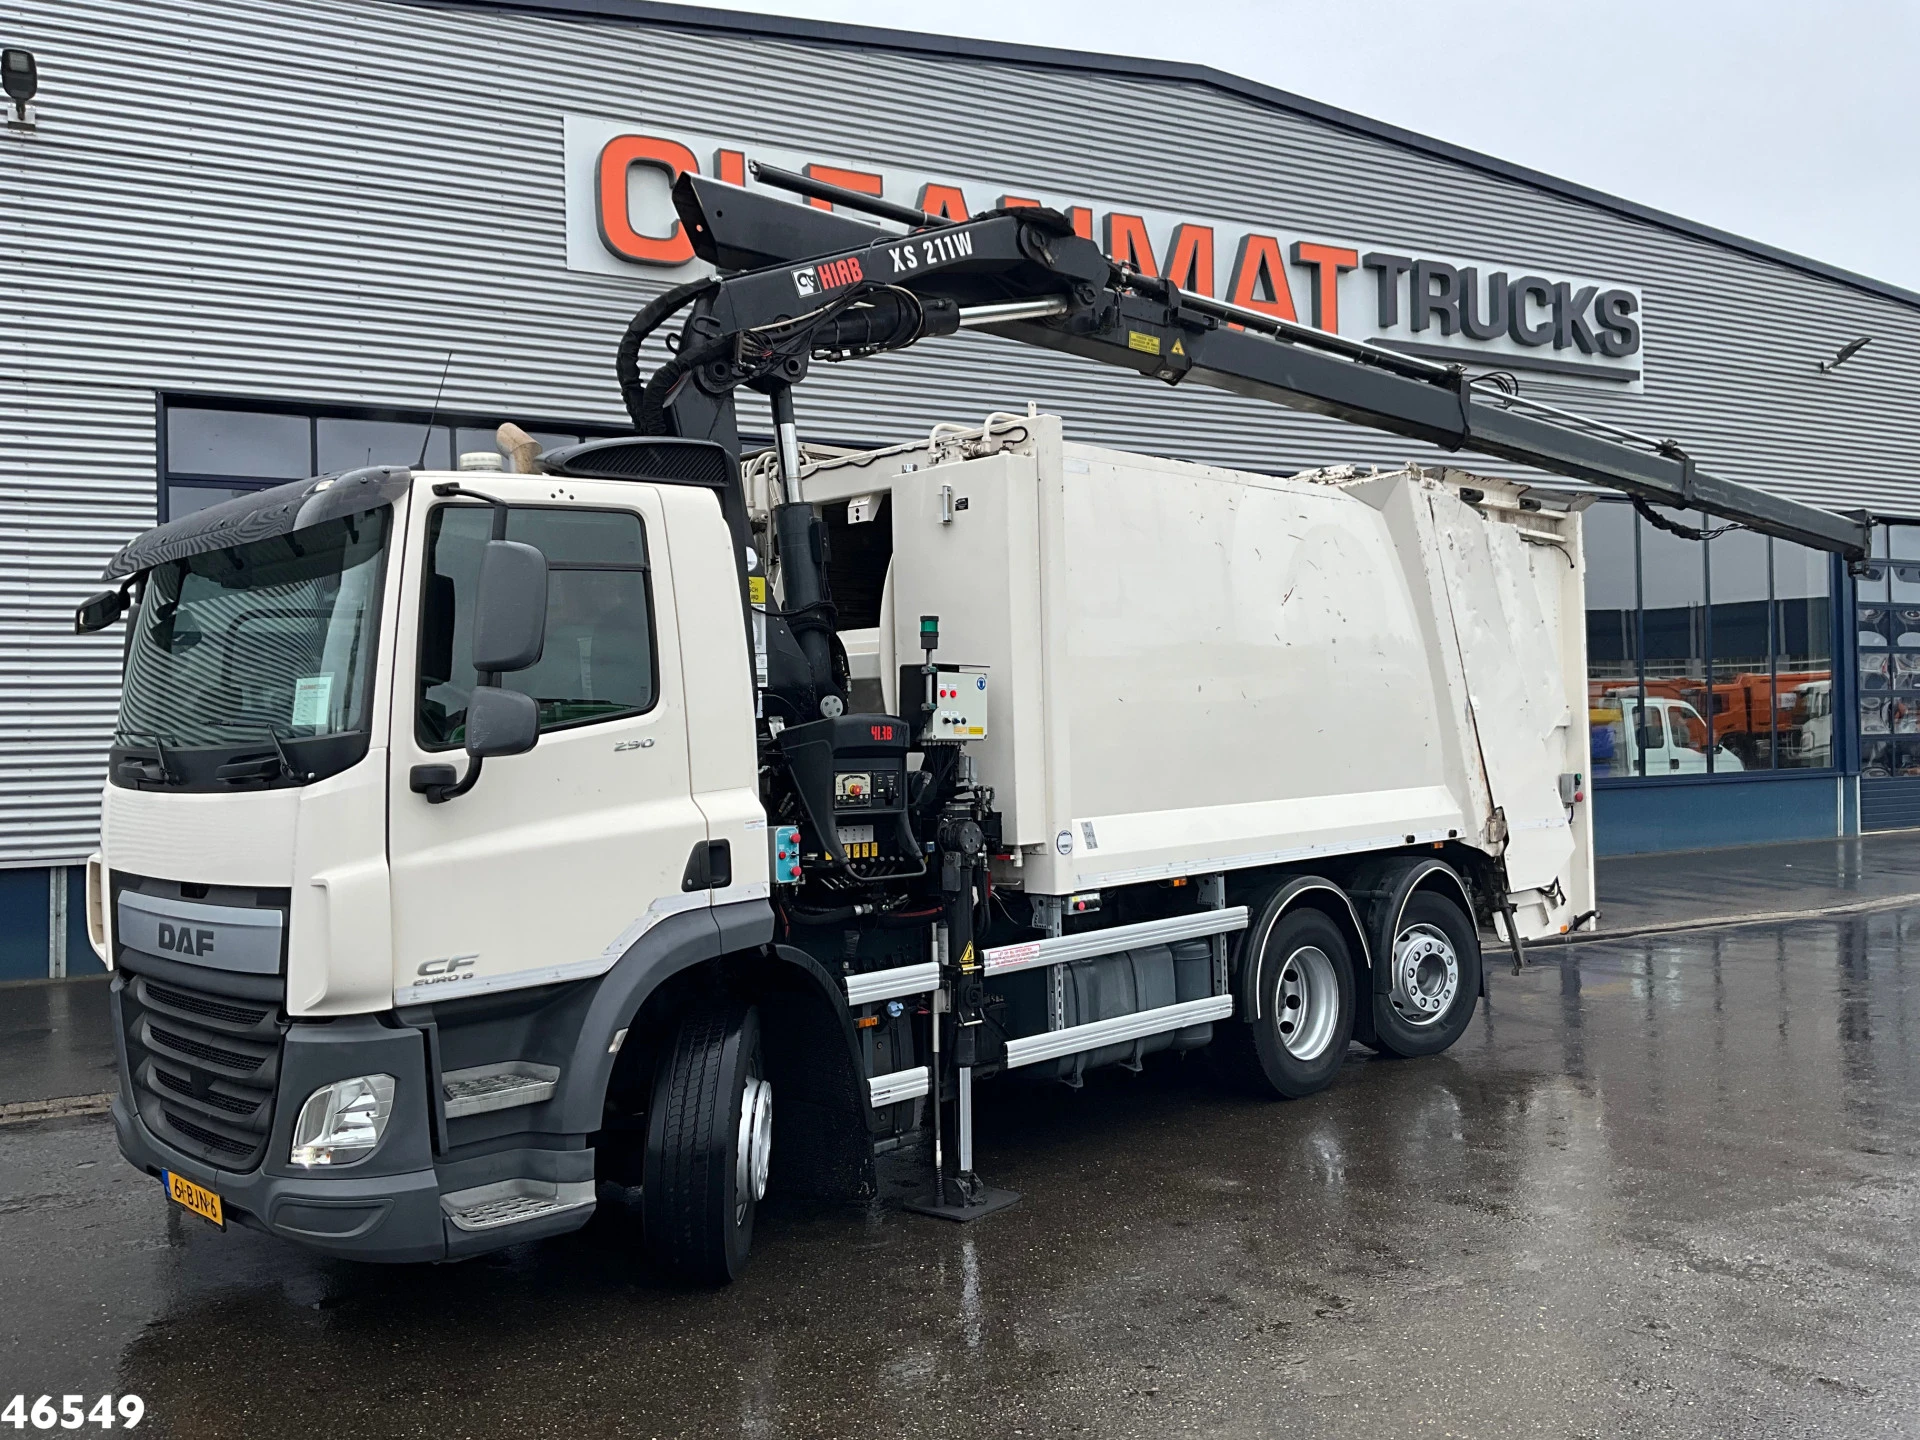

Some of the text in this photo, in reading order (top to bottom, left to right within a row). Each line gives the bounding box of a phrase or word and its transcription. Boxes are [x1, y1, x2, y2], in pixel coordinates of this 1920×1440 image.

[889, 231, 973, 273] XS 211W
[817, 257, 864, 290] HIAB
[1362, 251, 1640, 358] TRUCKS
[613, 738, 655, 752] 290
[158, 922, 215, 957] DAF
[412, 974, 460, 987] EURO
[417, 953, 480, 976] CF
